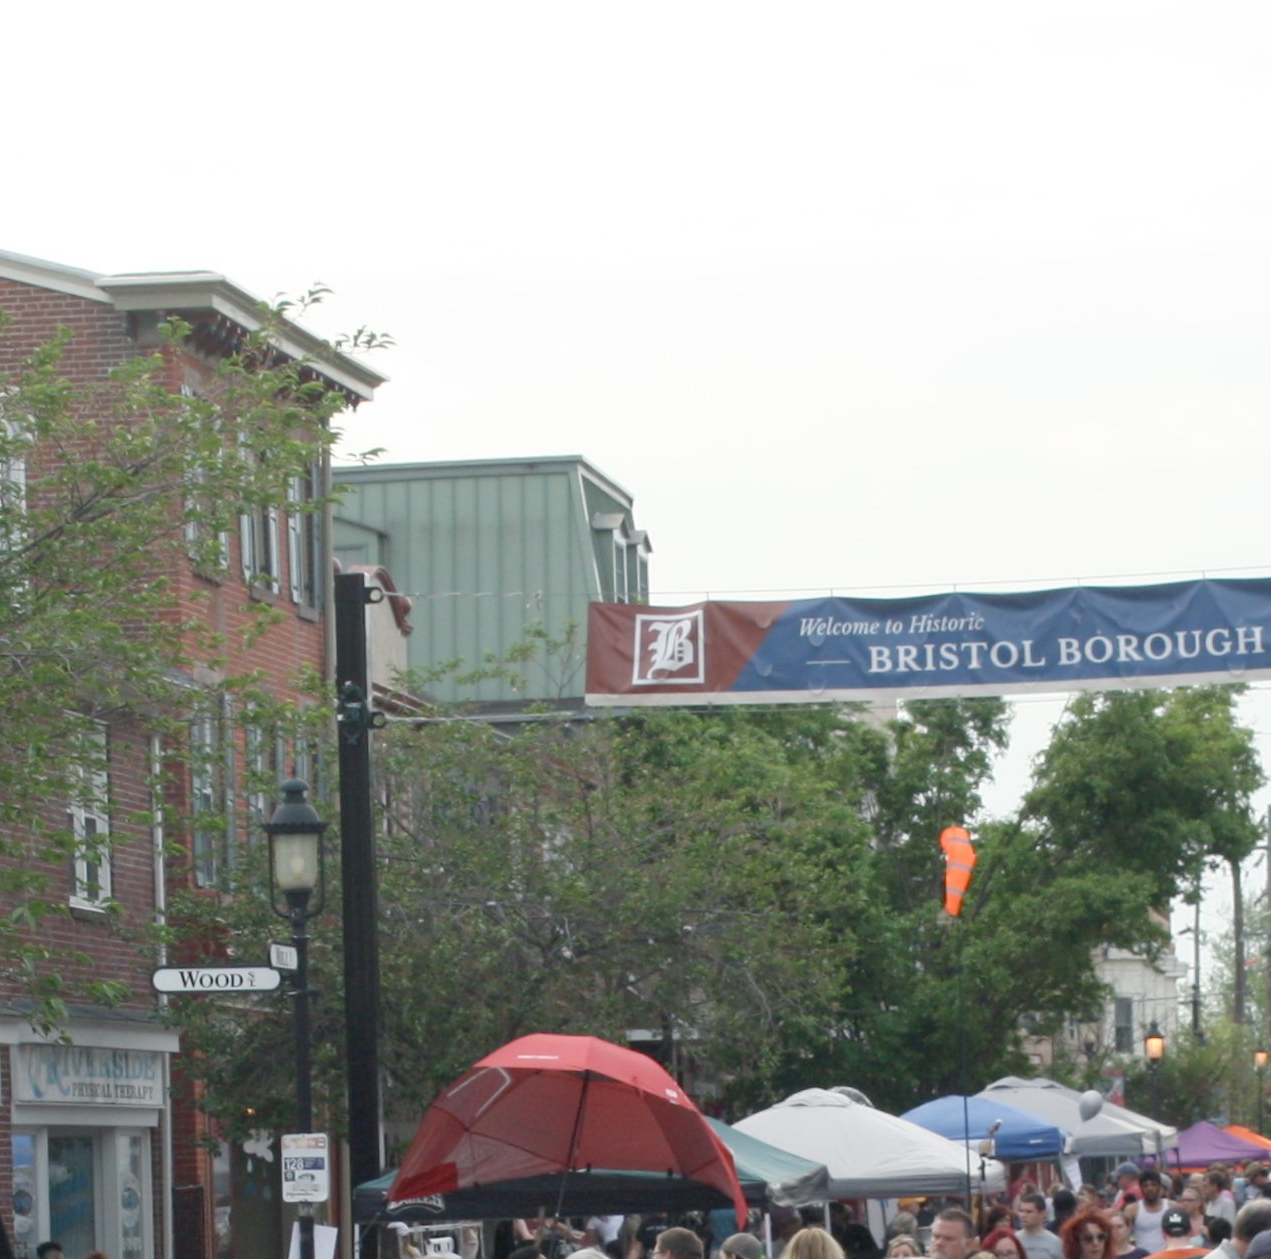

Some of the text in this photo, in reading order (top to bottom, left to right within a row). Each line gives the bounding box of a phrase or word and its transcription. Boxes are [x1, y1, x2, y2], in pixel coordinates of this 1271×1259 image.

[799, 611, 985, 637] Welcome to Historic
[646, 618, 695, 680] B
[868, 626, 1265, 674] BRISTOL BOROUGH
[179, 970, 243, 989] WOOD
[42, 1047, 156, 1096] RIVERSIDE
[72, 1081, 154, 1099] PHYSICAL THERAPY
